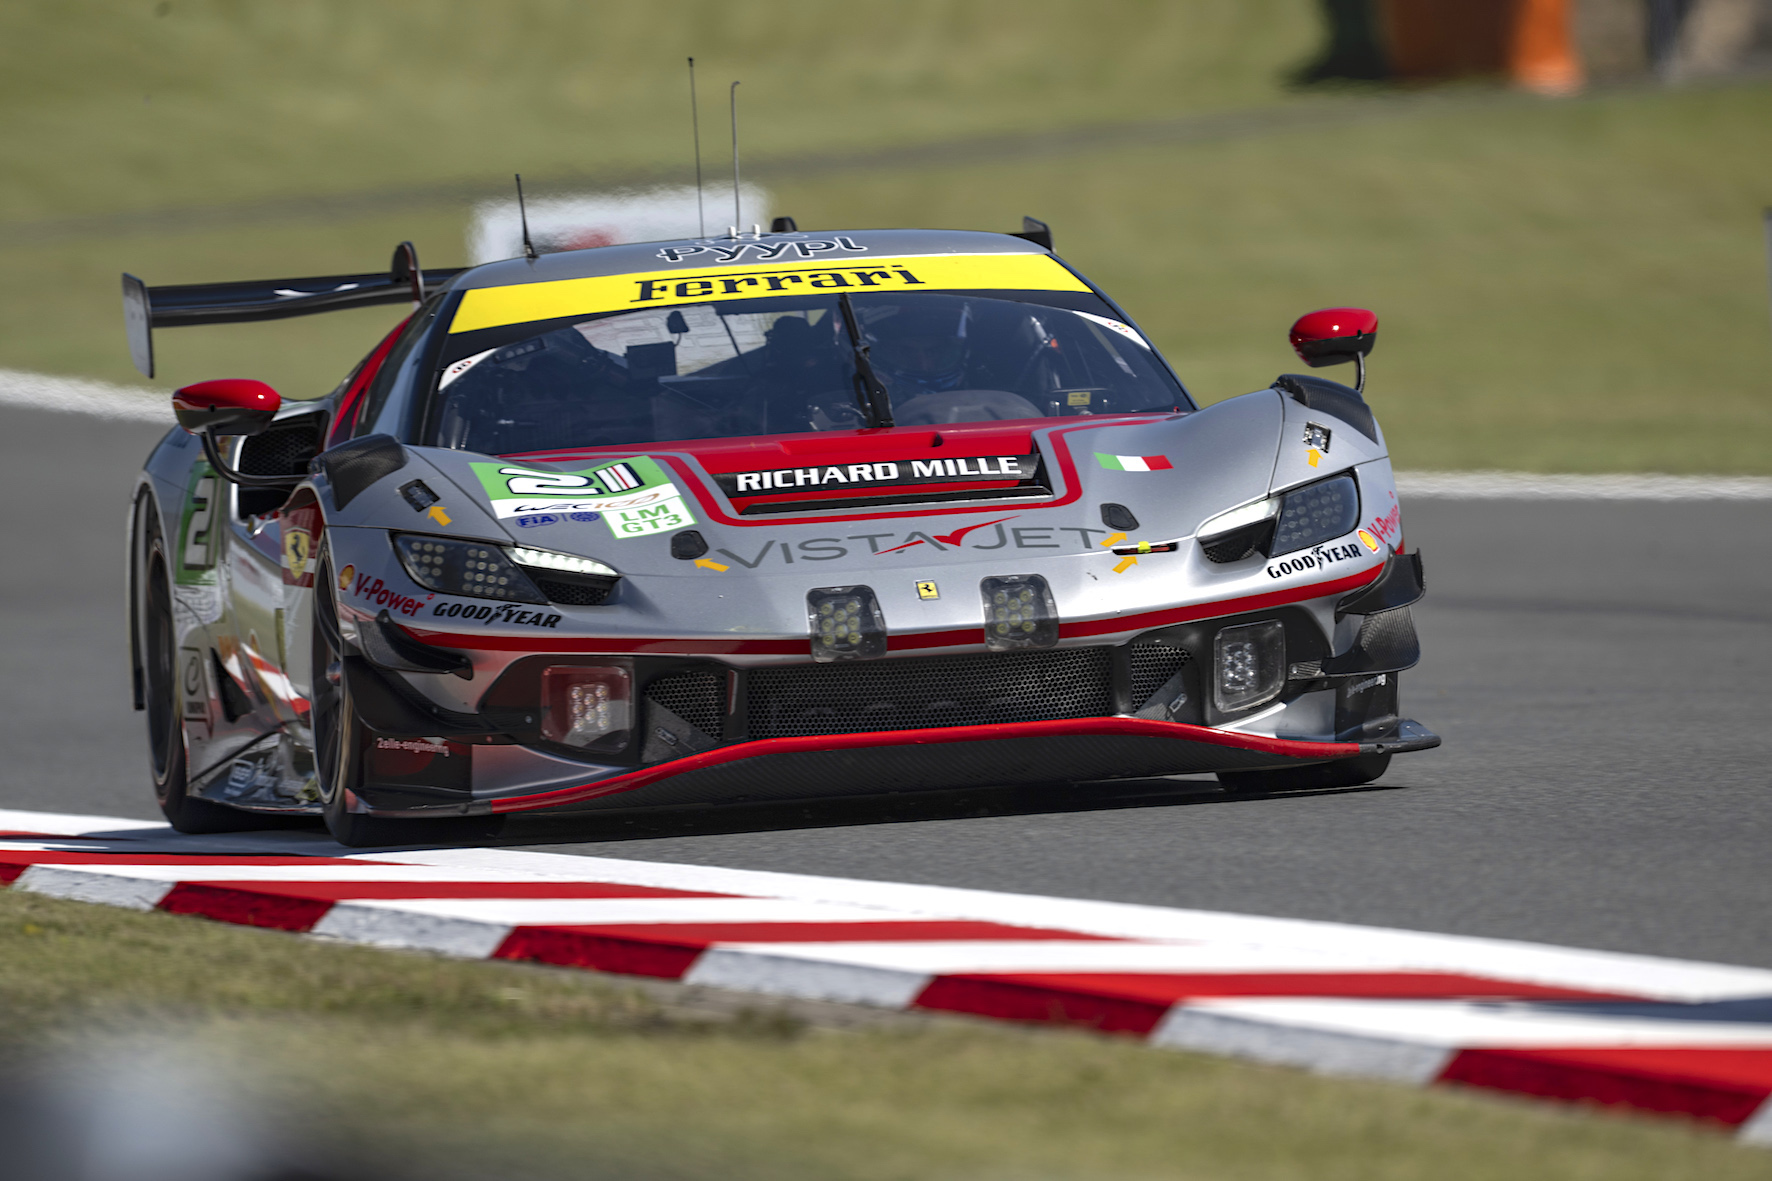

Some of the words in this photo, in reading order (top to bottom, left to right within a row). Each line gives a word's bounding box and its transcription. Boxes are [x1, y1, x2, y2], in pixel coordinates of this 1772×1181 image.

[630, 264, 927, 303] Ferrari
[736, 461, 899, 492] RICHARD
[910, 456, 1022, 479] MILLE
[519, 515, 554, 528] FIA
[620, 503, 671, 522] LM
[621, 514, 683, 533] GT3
[1267, 544, 1363, 579] GOODYEAR
[354, 572, 425, 617] V-Power
[433, 602, 562, 629] GOODYEAR
